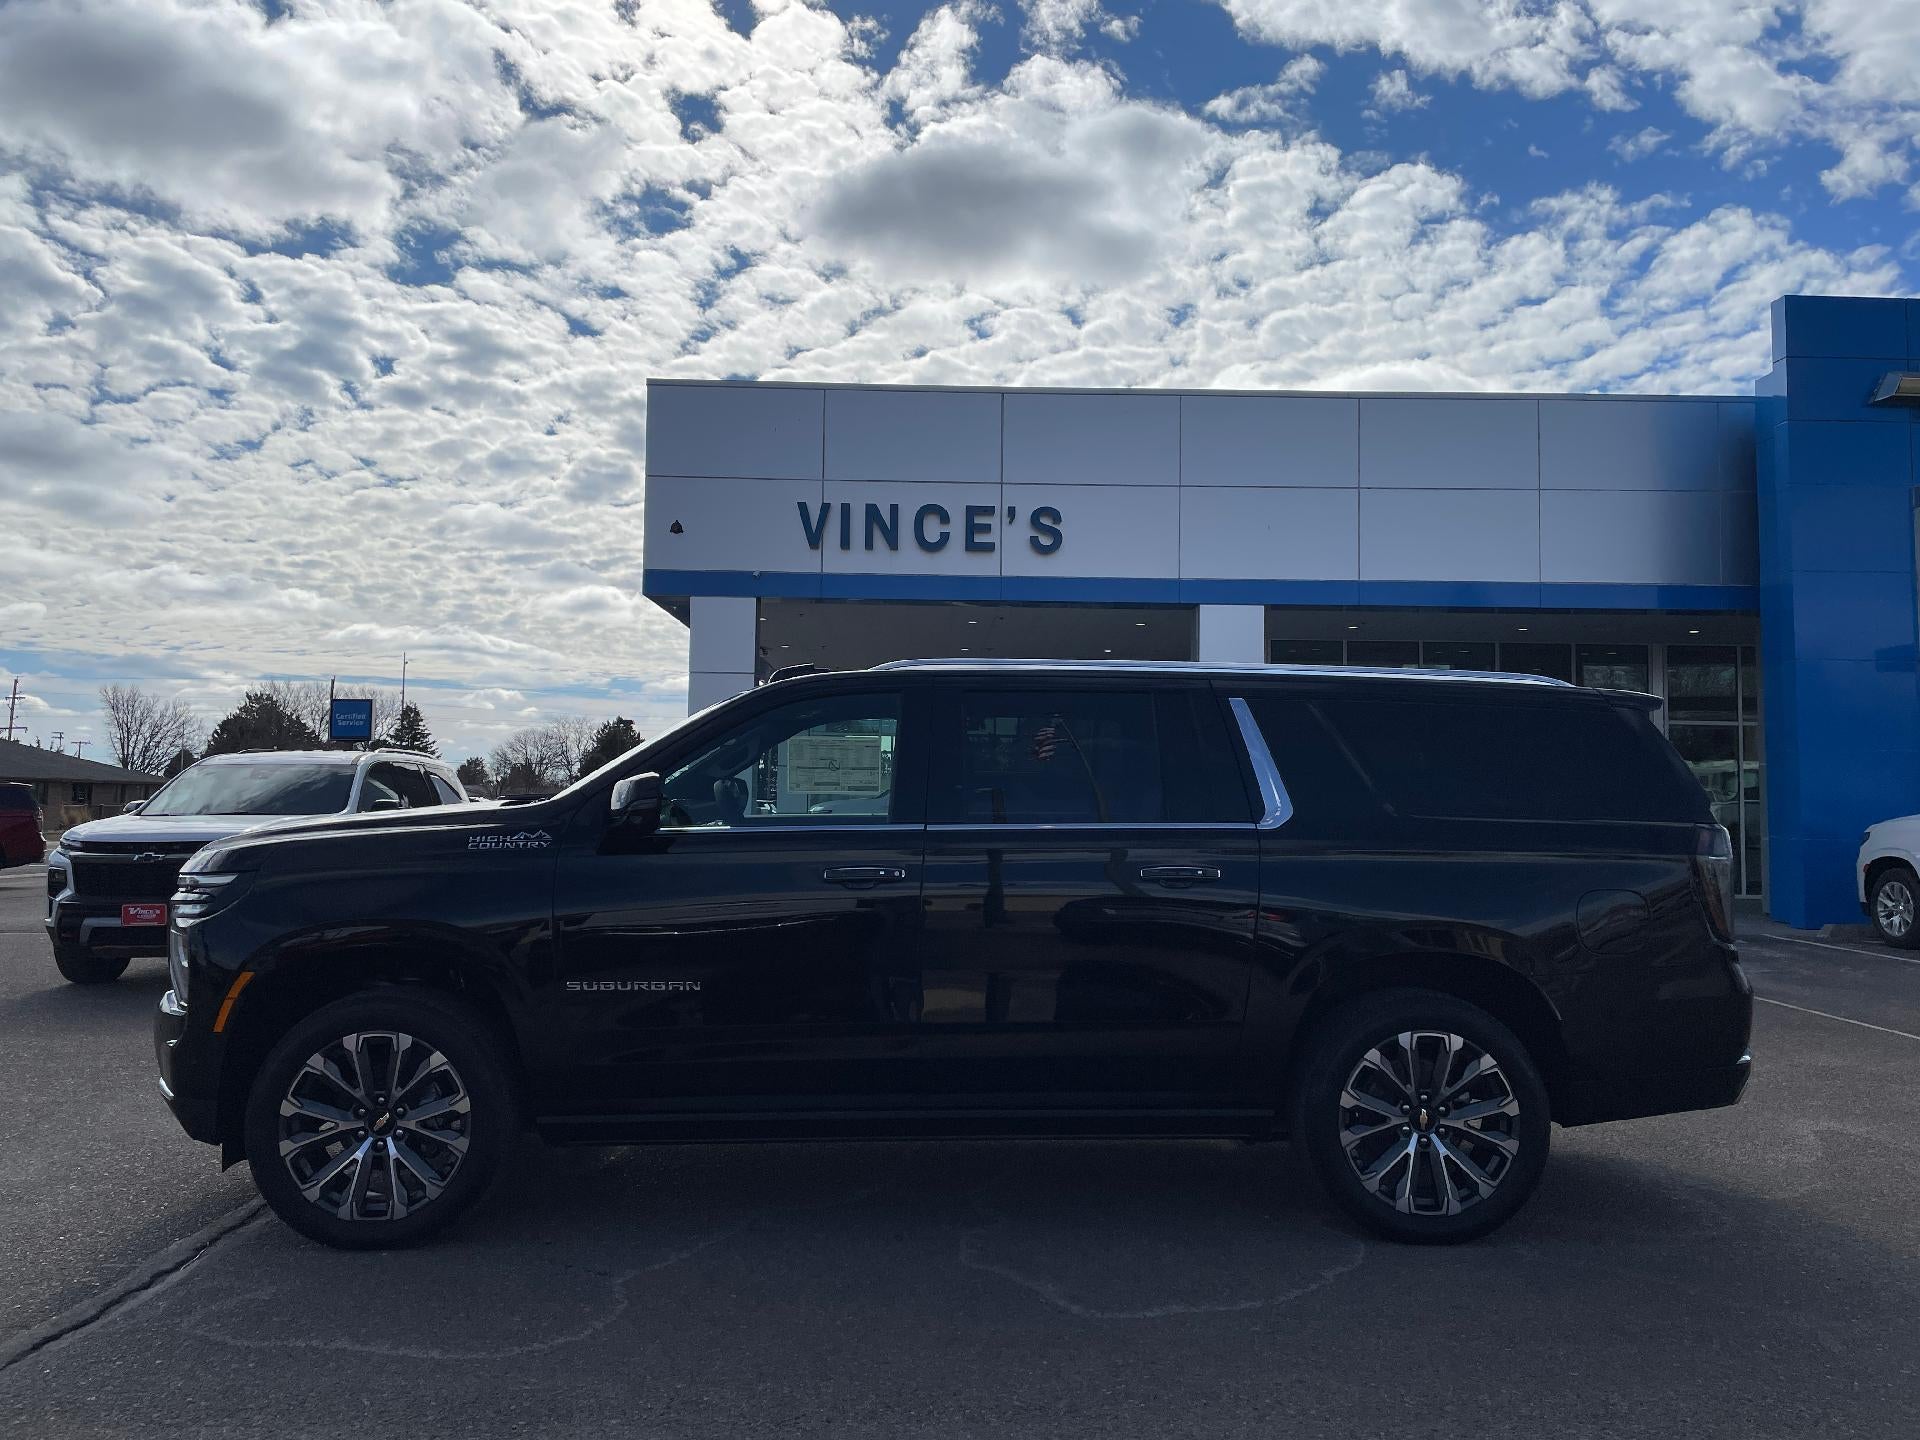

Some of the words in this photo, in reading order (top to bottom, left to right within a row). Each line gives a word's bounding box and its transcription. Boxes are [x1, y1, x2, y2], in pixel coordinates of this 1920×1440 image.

[796, 501, 1064, 555] VINCE'S
[467, 841, 551, 850] COUNTRY
[566, 981, 701, 991] SUBURBAN
